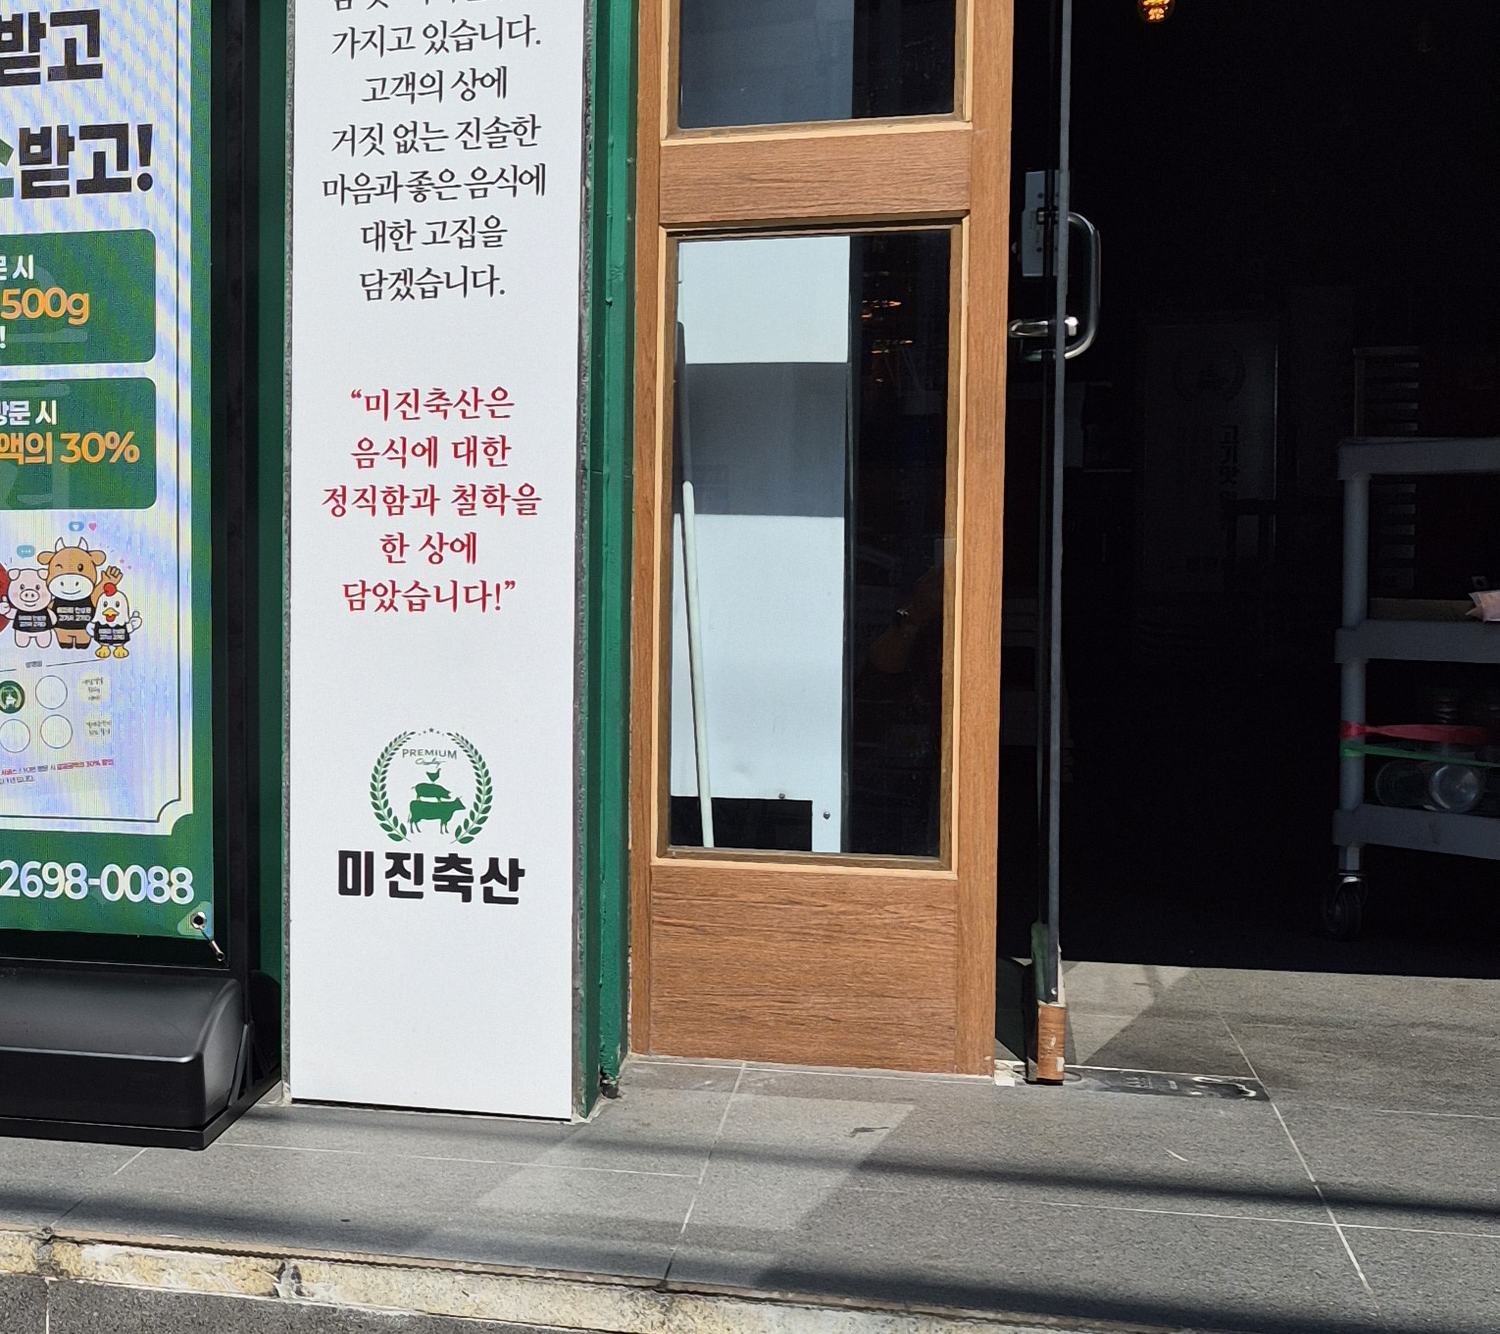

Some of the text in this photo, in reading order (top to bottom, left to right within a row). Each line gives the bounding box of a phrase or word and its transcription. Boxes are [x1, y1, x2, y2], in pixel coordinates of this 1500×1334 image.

[332, 14, 541, 60] 가지고 있습니다.
[362, 66, 508, 105] 고객의 상에
[332, 113, 541, 158] 거짓 없는 진솔한
[360, 214, 508, 254] 대한 고집을
[12, 254, 34, 280] 시
[360, 264, 506, 302] 담겠습니다.
[1, 287, 90, 325] 500g
[35, 400, 57, 425] 시
[350, 386, 515, 422] “미진축산은
[60, 431, 140, 464] 30%
[350, 434, 511, 470] 음식에 대한
[321, 483, 542, 518] 정직함과 철학을
[380, 532, 477, 565] 한 상에
[342, 579, 516, 613] 담았습니다!”
[402, 748, 457, 760] PREMIUM
[337, 849, 525, 905] 미진축산
